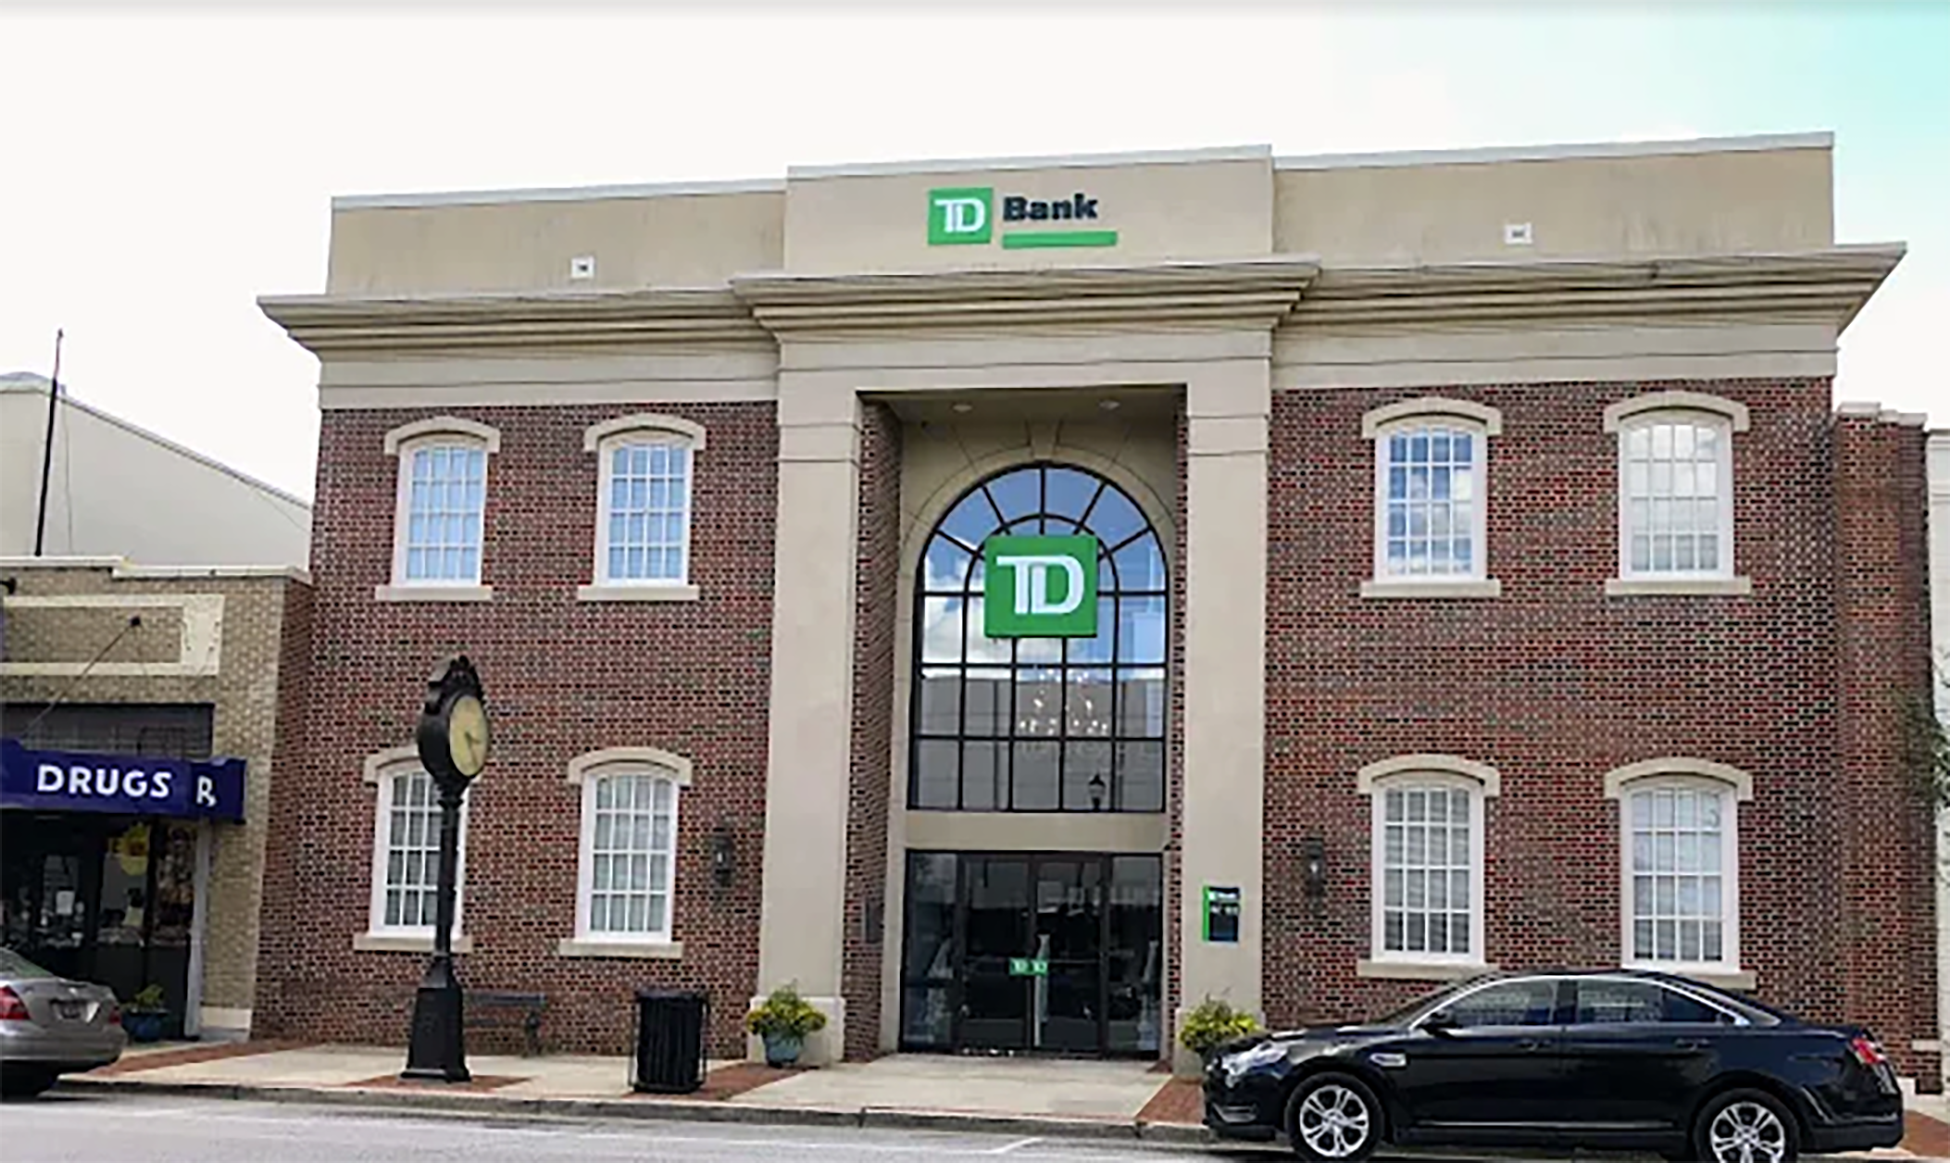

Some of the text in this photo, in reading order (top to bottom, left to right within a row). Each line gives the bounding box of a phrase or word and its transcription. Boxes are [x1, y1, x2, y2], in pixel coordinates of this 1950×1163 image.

[934, 192, 1099, 233] TD Bank
[996, 555, 1085, 615] TD
[36, 763, 173, 798] DRUGS
